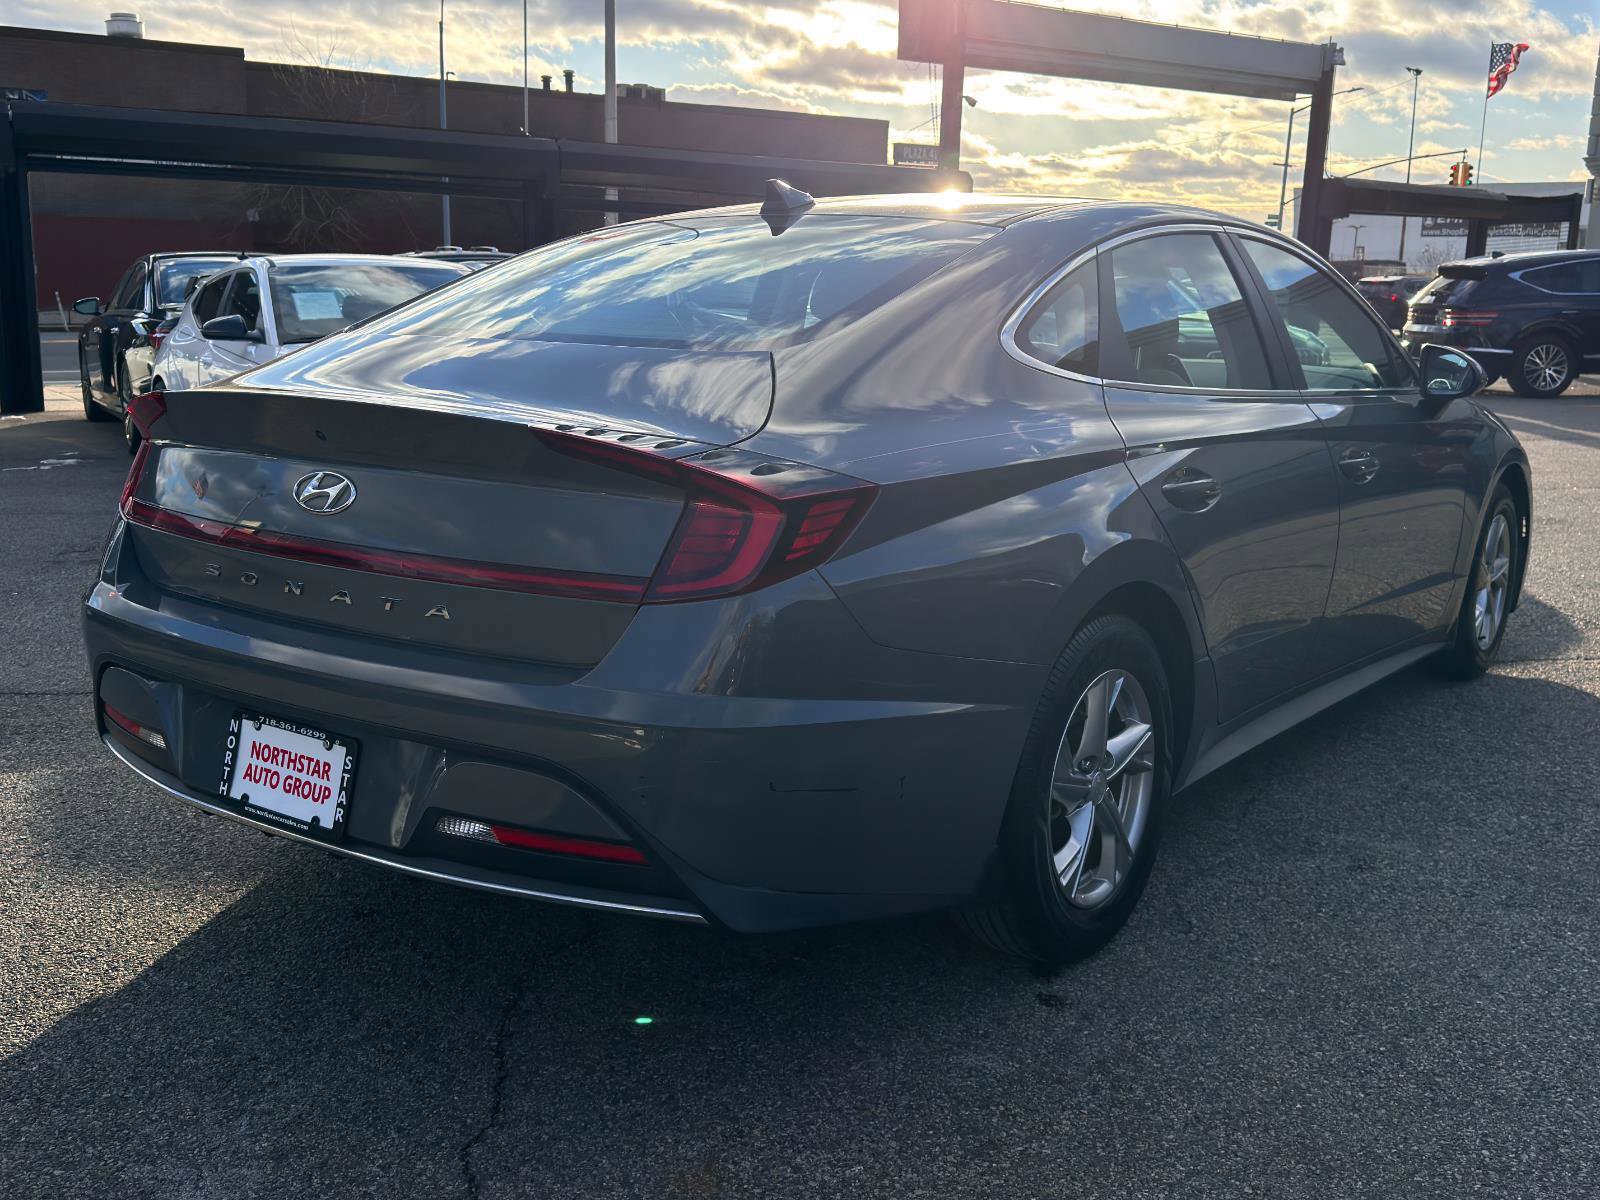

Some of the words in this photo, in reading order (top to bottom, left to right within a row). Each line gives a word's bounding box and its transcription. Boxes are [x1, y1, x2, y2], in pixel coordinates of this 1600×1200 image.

[205, 563, 450, 620] SONATA
[259, 716, 326, 740] 718-361-6299
[219, 719, 239, 796] NORTH
[250, 741, 332, 782] NORTHSTAR
[242, 763, 280, 790] AUTO
[282, 775, 332, 805] GROUP
[335, 756, 353, 823] STAR
